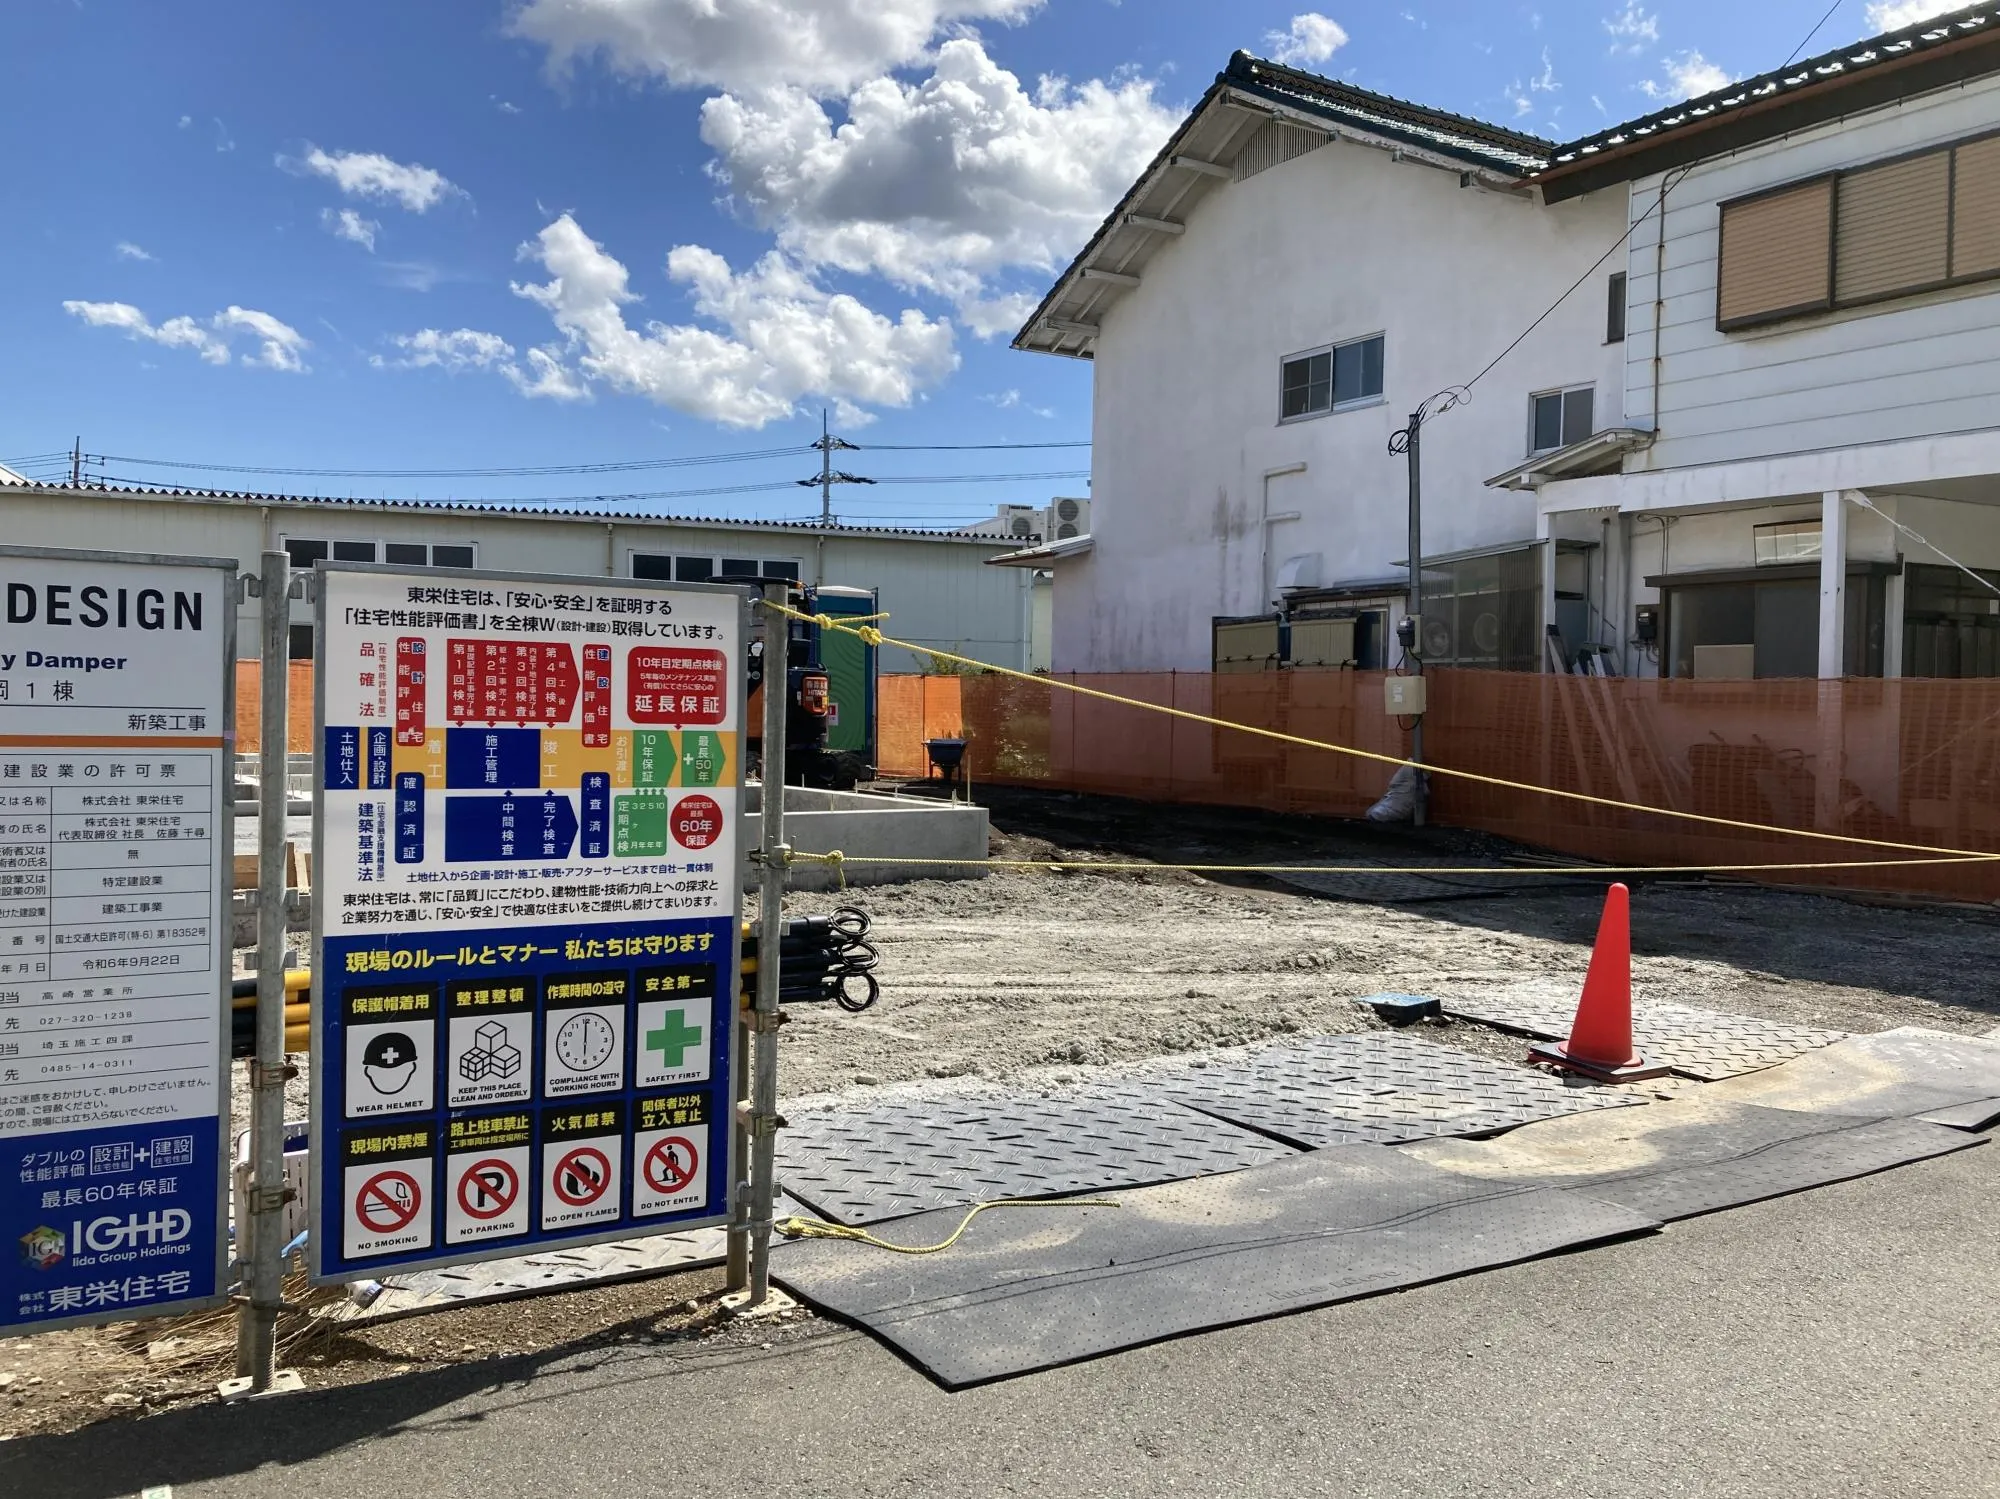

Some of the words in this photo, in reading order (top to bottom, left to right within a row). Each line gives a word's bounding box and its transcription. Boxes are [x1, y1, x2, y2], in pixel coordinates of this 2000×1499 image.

[7, 582, 202, 631] DESIGN
[407, 586, 672, 616] 東栄住宅は、「安心・安全」を証明する
[26, 651, 128, 673] Damper
[636, 657, 722, 671] 10年目定期点検後
[359, 642, 375, 717] 品確法
[453, 643, 464, 716] 第1回検査
[485, 645, 497, 717] 第2回検査
[515, 646, 527, 717] 第3回検査
[545, 647, 556, 718] 第4回検査
[634, 694, 720, 714] 延長保証
[127, 714, 206, 732] 新築工事
[340, 732, 353, 785] 土地仕入
[373, 732, 386, 785] 企画・設計
[427, 739, 443, 778] 着工
[485, 735, 498, 783] 施工管理
[543, 740, 558, 778] 竣工
[3, 763, 177, 779] 建設業の許可票
[82, 796, 131, 806] 株式会社
[136, 795, 184, 806] 東栄住宅
[136, 816, 181, 827] 東栄住宅
[403, 777, 417, 859] 確認済証
[588, 776, 602, 854] 検査済証
[501, 802, 515, 856] 中間検査
[543, 802, 556, 855] 完了検査
[617, 800, 630, 852] 定期点検
[679, 820, 713, 833] 60年
[358, 802, 374, 882] 建築基準法
[685, 835, 707, 847] 保証
[127, 849, 139, 860] 無
[102, 876, 164, 888] 特定建設業
[102, 902, 163, 914] 建築工事業
[82, 954, 180, 970] 令和6年9月22日
[345, 941, 559, 973] 現場のルールとマナー
[565, 932, 714, 961] 私たちは守ります
[547, 980, 625, 1000] 作業時間の遵守
[645, 975, 706, 992] 安全第一
[352, 994, 430, 1014] 保護帽着用
[456, 987, 524, 1007] 整理整頓
[549, 1074, 599, 1085] COMPLIANCE
[552, 1083, 589, 1093] WORKING
[590, 1080, 616, 1089] HOURS
[645, 1074, 676, 1083] SAFETY
[678, 1071, 701, 1080] FIRST
[356, 1103, 383, 1113] WEAR
[386, 1100, 424, 1110] HELMET
[451, 1095, 476, 1103] CLEAN
[494, 1090, 528, 1099] ORDERLY
[642, 1095, 701, 1112] 関係者以外
[450, 1115, 529, 1137] 路上駐車禁止
[551, 1111, 616, 1132] 火気厳禁
[641, 1108, 702, 1128] 立入禁止
[21, 1149, 85, 1168] ダブルの
[94, 1146, 130, 1164] 設計
[155, 1139, 190, 1157] 建設
[350, 1132, 428, 1155] 現場内禁煙
[19, 1163, 85, 1184] 性能評価
[40, 1176, 178, 1209] 最長60年保証
[654, 1200, 671, 1208] NOT
[673, 1196, 699, 1205] ENTER
[560, 1212, 583, 1222] OPEN
[585, 1207, 618, 1218] FLAMES
[460, 1227, 473, 1235] NO
[475, 1222, 515, 1234] PARKING
[358, 1242, 372, 1250] NO
[374, 1235, 418, 1248] SMOKING
[99, 1250, 137, 1264] Group
[140, 1243, 191, 1258] Holdings
[48, 1270, 191, 1312] 東栄住宅
